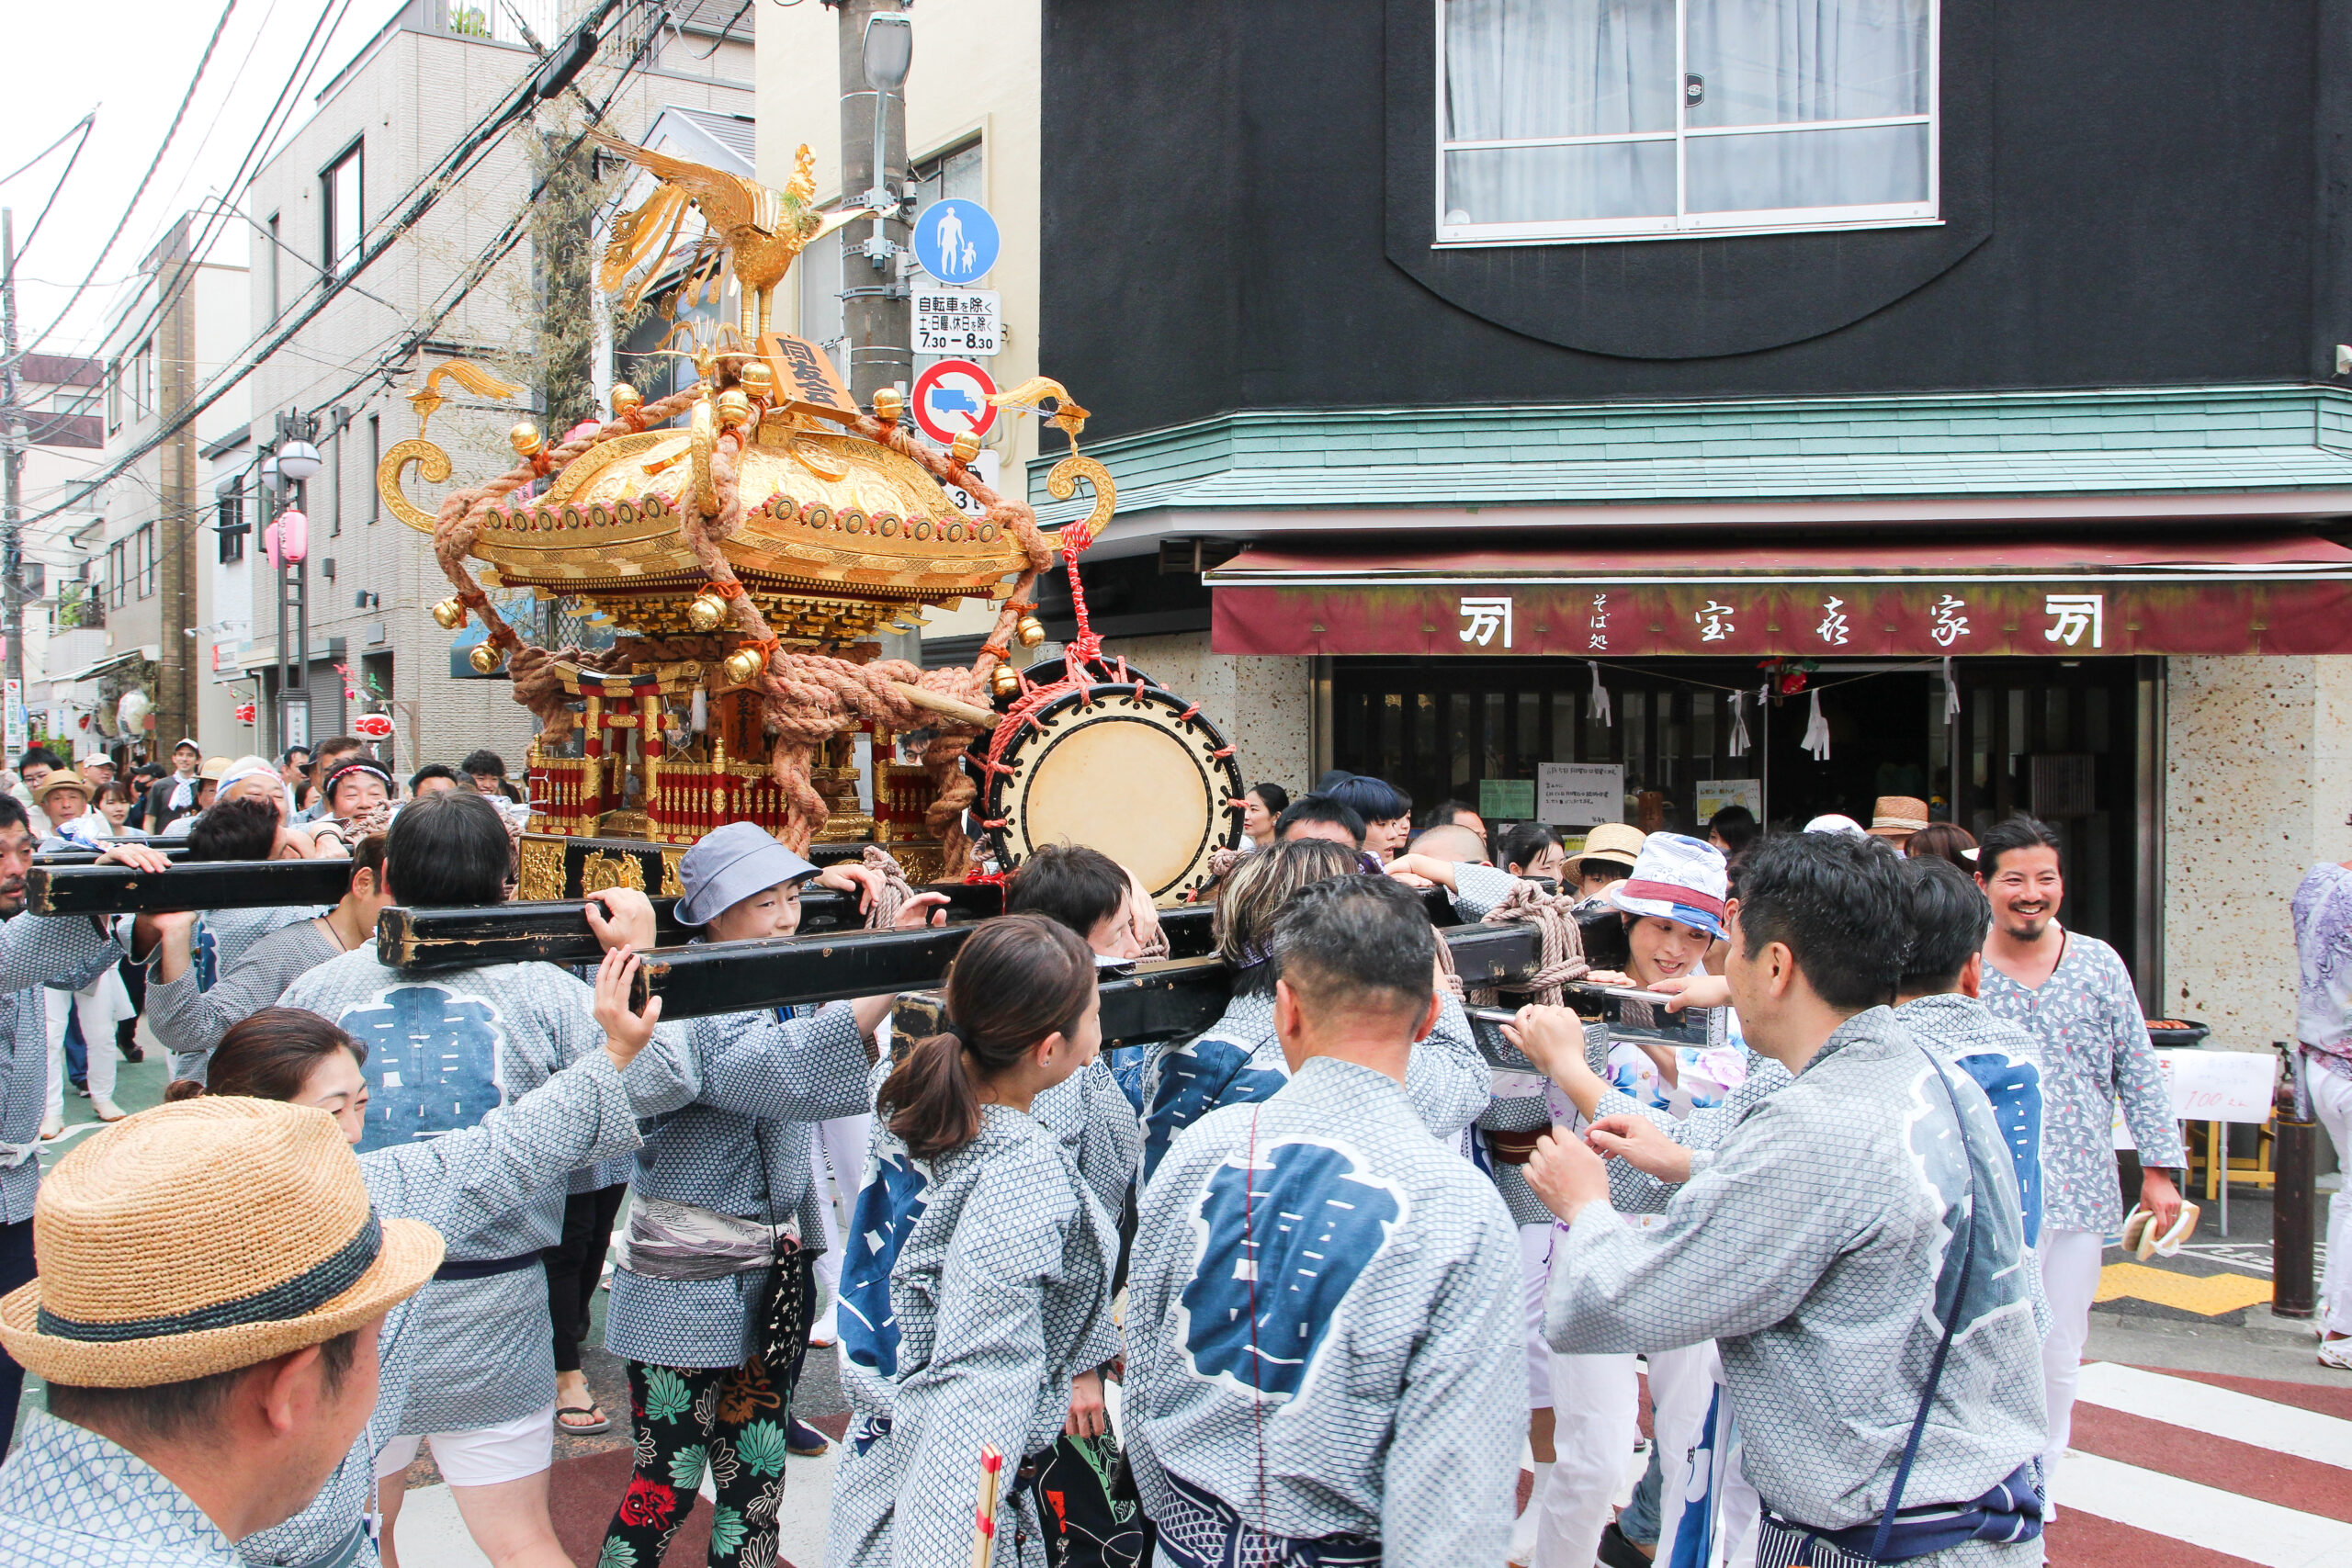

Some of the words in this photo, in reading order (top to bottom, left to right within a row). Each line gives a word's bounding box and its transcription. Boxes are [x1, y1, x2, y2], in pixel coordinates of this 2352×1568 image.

[919, 297, 992, 313] 自転車を除く
[919, 332, 946, 348] 7.30
[966, 333, 993, 349] 8.30
[1588, 593, 1611, 650] そば処
